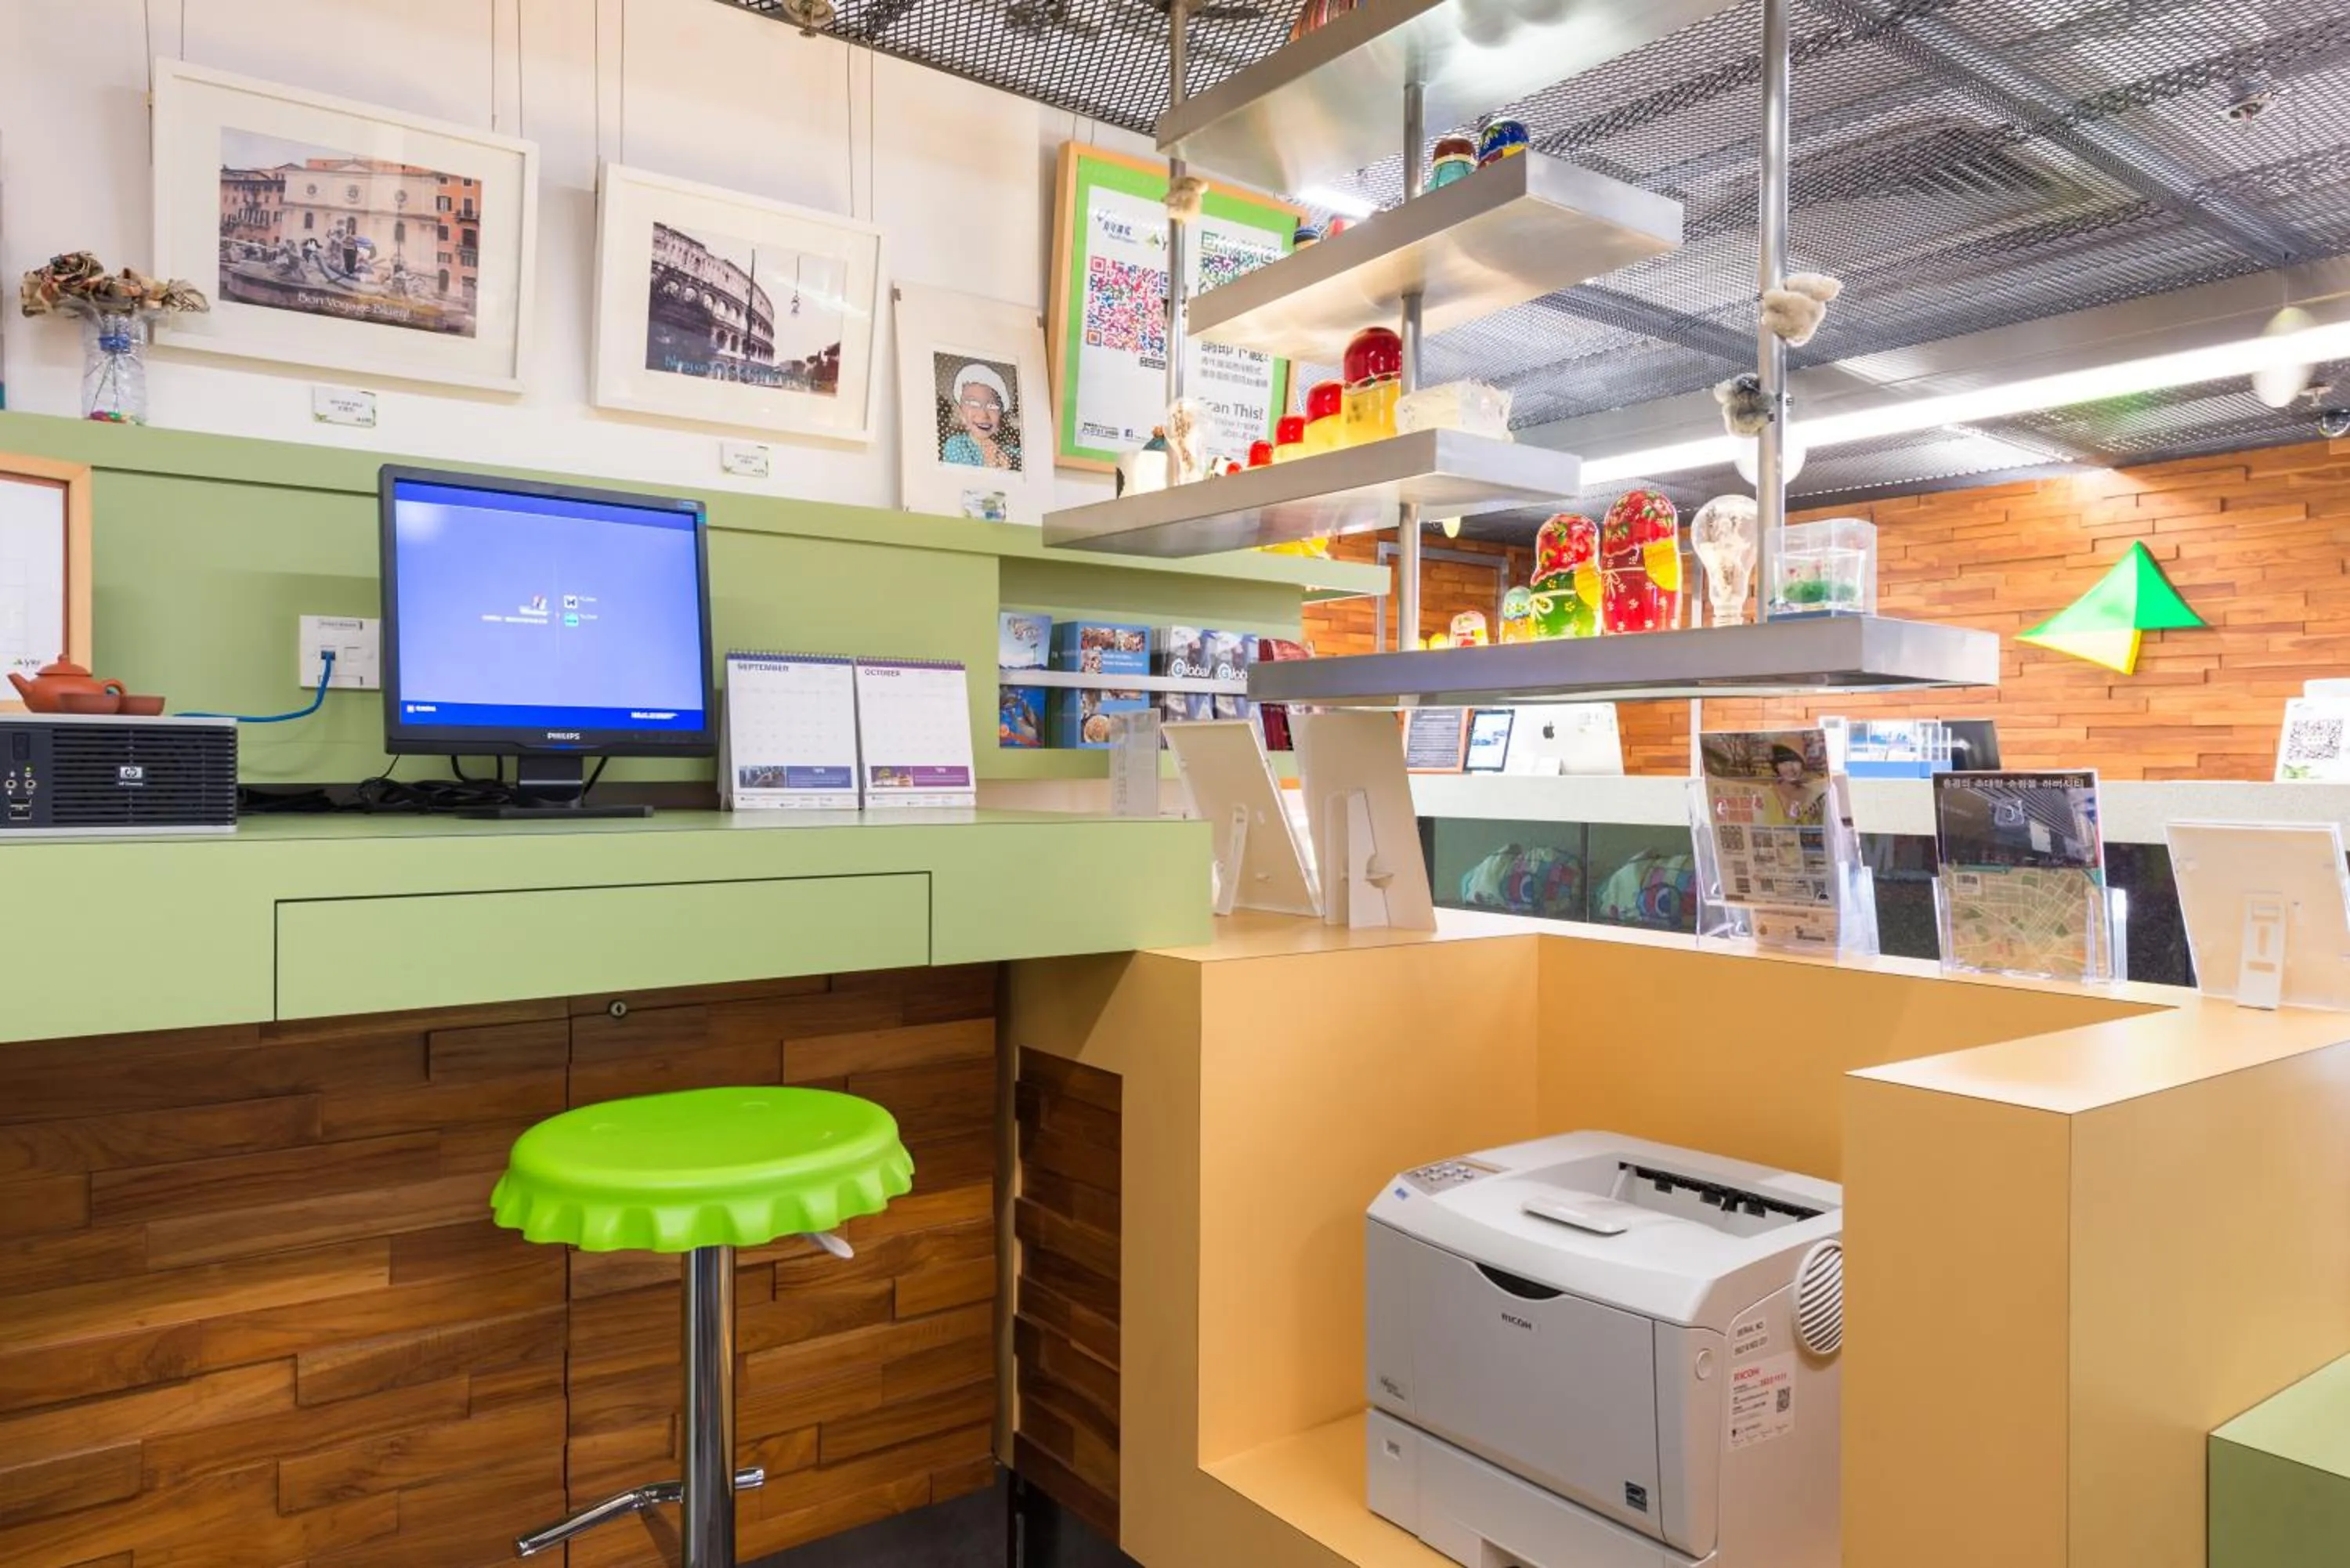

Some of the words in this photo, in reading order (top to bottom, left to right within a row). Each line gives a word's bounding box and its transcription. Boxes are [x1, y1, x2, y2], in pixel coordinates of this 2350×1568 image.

[1233, 403, 1264, 420] This!
[737, 663, 789, 672] SEPTEMBER
[864, 668, 901, 677] OCTOBER
[1171, 659, 1211, 678] Global
[1217, 663, 1247, 681] Glob
[1502, 1313, 1531, 1331] RICOH
[1734, 1368, 1759, 1382] RICOH
